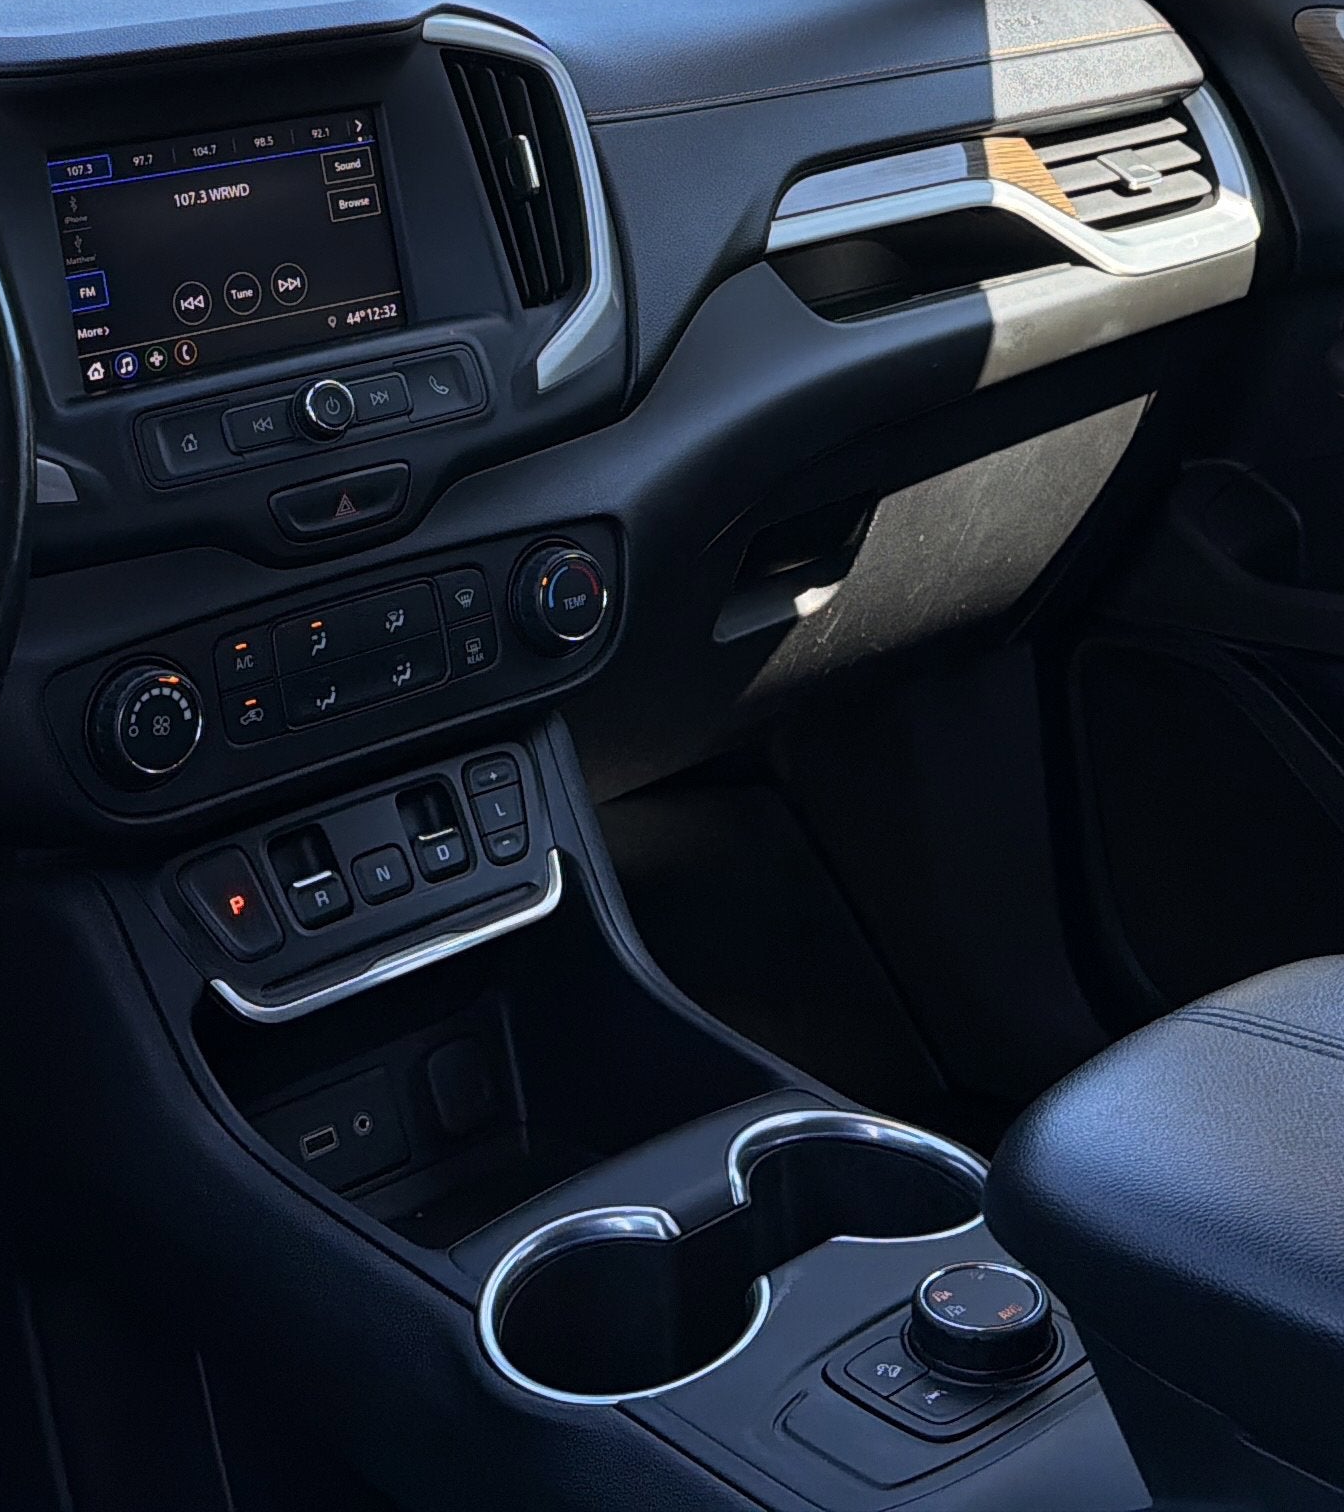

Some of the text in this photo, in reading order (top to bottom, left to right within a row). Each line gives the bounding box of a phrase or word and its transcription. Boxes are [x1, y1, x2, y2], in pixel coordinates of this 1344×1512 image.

[65, 127, 330, 178] 107.3 97.7 104.7 98.5 92.1
[334, 158, 361, 172] Sound
[173, 183, 250, 209] 107.3 WRWD
[338, 195, 370, 210] Browse
[79, 286, 96, 299] FM
[231, 288, 253, 300] Tune
[562, 594, 587, 611] TEMP
[235, 653, 254, 671] A/C
[466, 652, 485, 665] REAR
[495, 802, 507, 818] L
[436, 844, 452, 861] D
[375, 865, 391, 882] N
[229, 895, 245, 915] P
[315, 890, 331, 908] R
